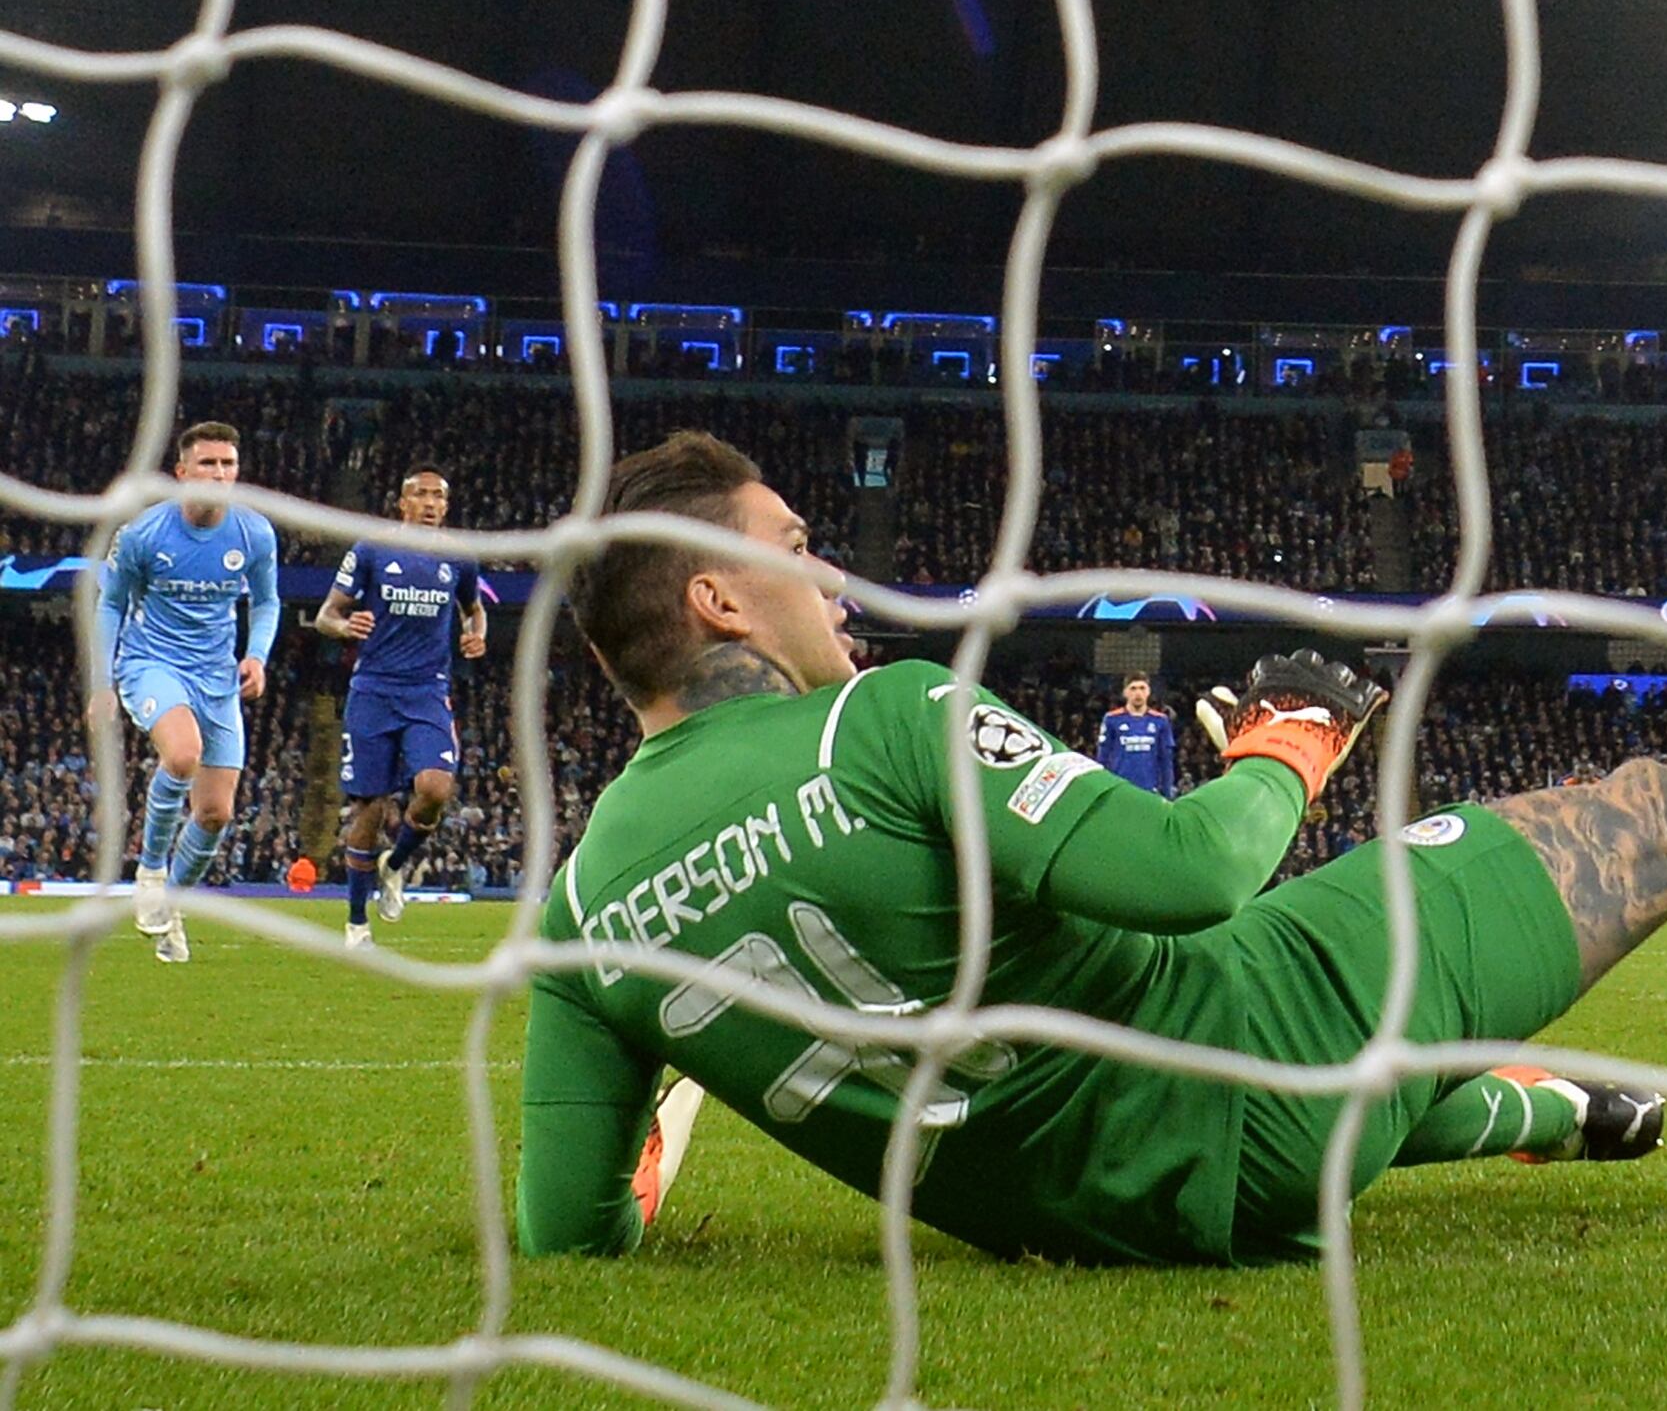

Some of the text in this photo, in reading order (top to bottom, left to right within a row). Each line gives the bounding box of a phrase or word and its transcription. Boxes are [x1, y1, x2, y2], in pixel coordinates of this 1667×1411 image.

[381, 584, 450, 604] Emirates
[582, 773, 867, 988] EDERSON M.
